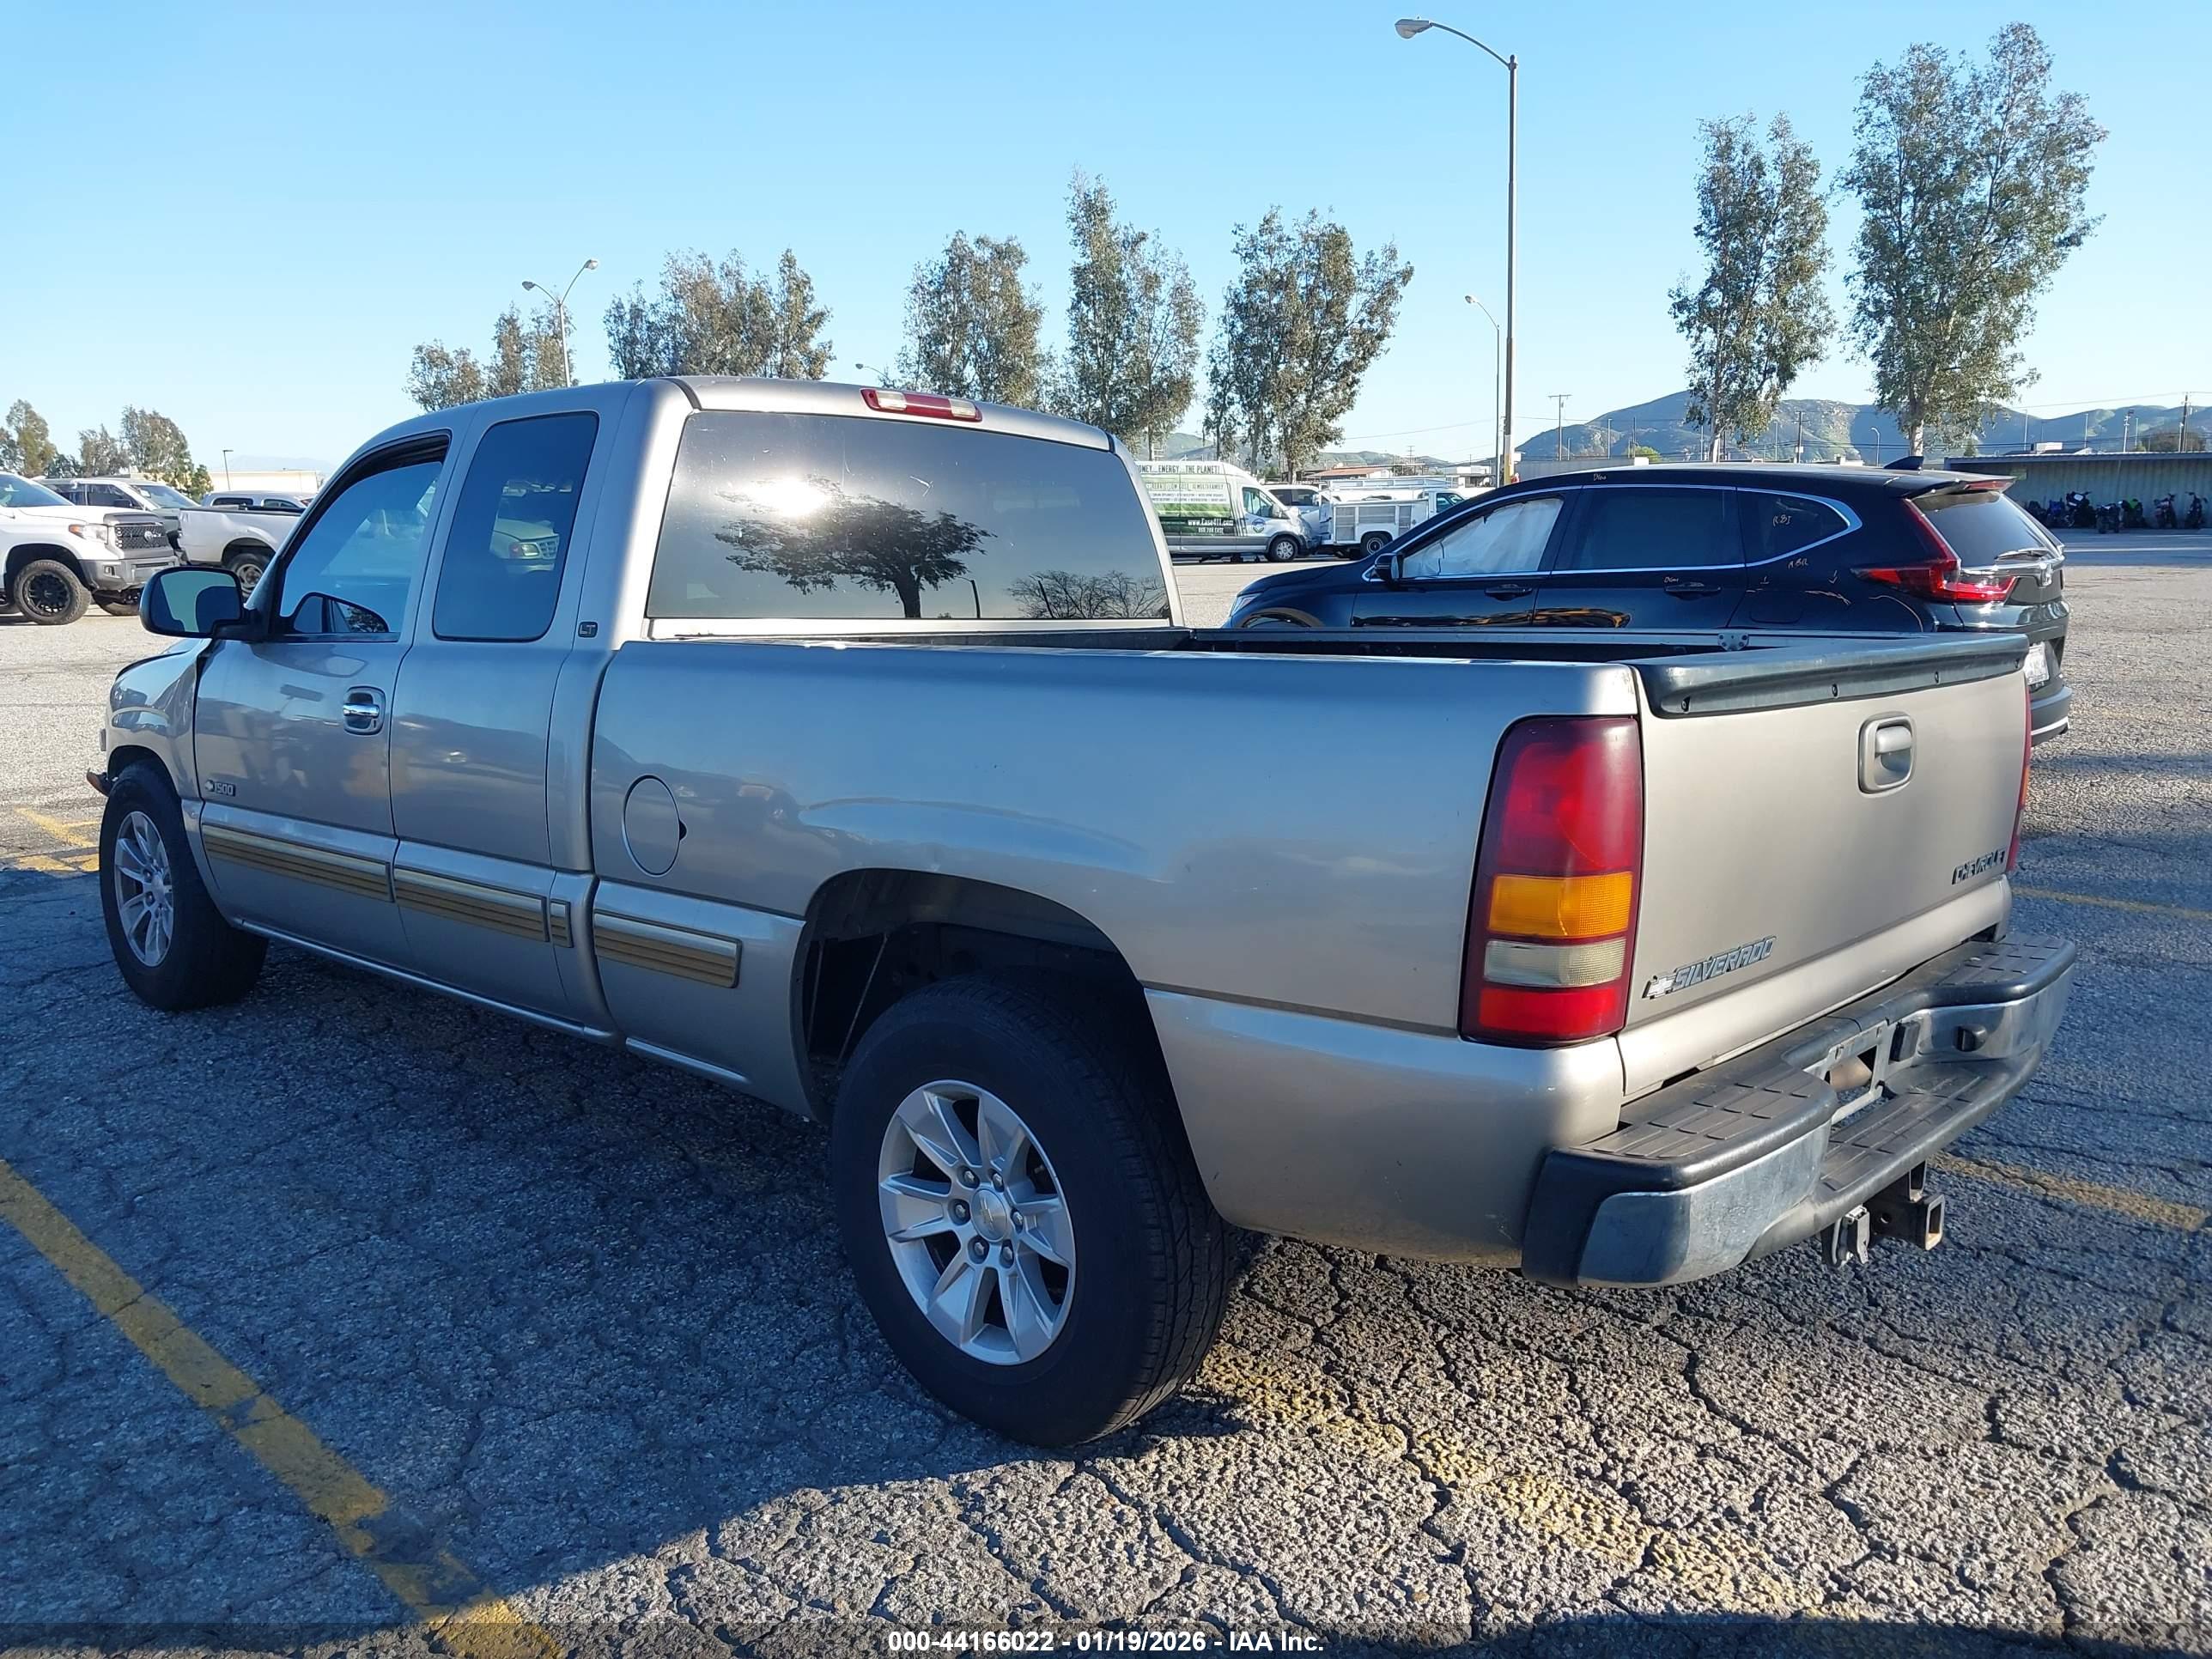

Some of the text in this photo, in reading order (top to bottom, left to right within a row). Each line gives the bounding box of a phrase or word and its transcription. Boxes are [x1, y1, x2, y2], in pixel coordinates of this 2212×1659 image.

[579, 623, 597, 635] LT
[215, 781, 236, 797] 1500
[1672, 937, 1775, 992] SILVERADO
